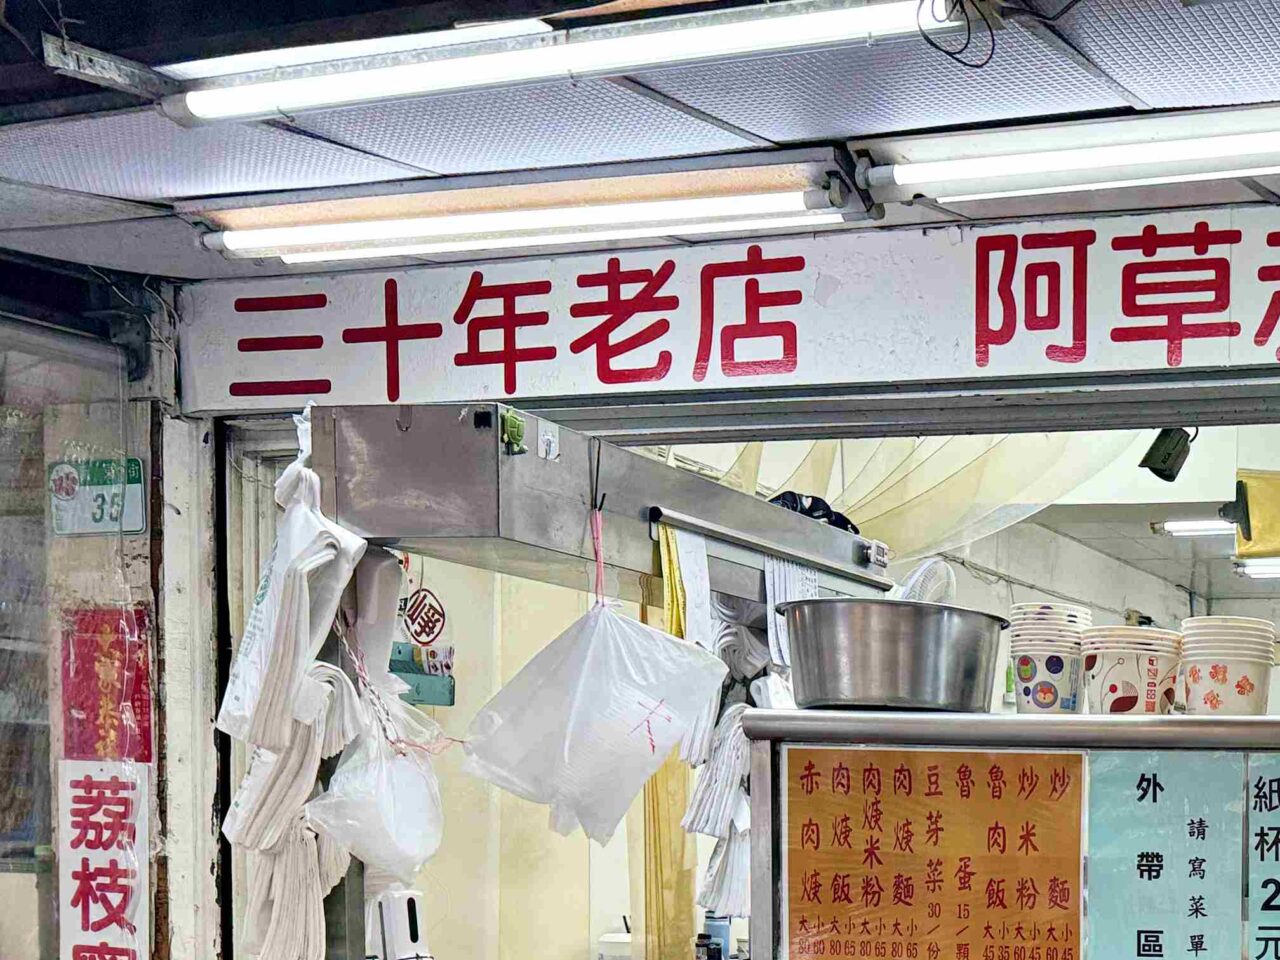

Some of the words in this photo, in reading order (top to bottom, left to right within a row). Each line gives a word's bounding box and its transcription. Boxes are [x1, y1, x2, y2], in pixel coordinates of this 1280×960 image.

[229, 244, 805, 402] 三十年老店
[924, 765, 944, 893] 豆芽菜
[985, 763, 1007, 910] 魯肉飯
[1016, 766, 1040, 910] 炒米粉
[1136, 773, 1165, 958] 外帶區
[1186, 817, 1208, 956] 請寫菜單
